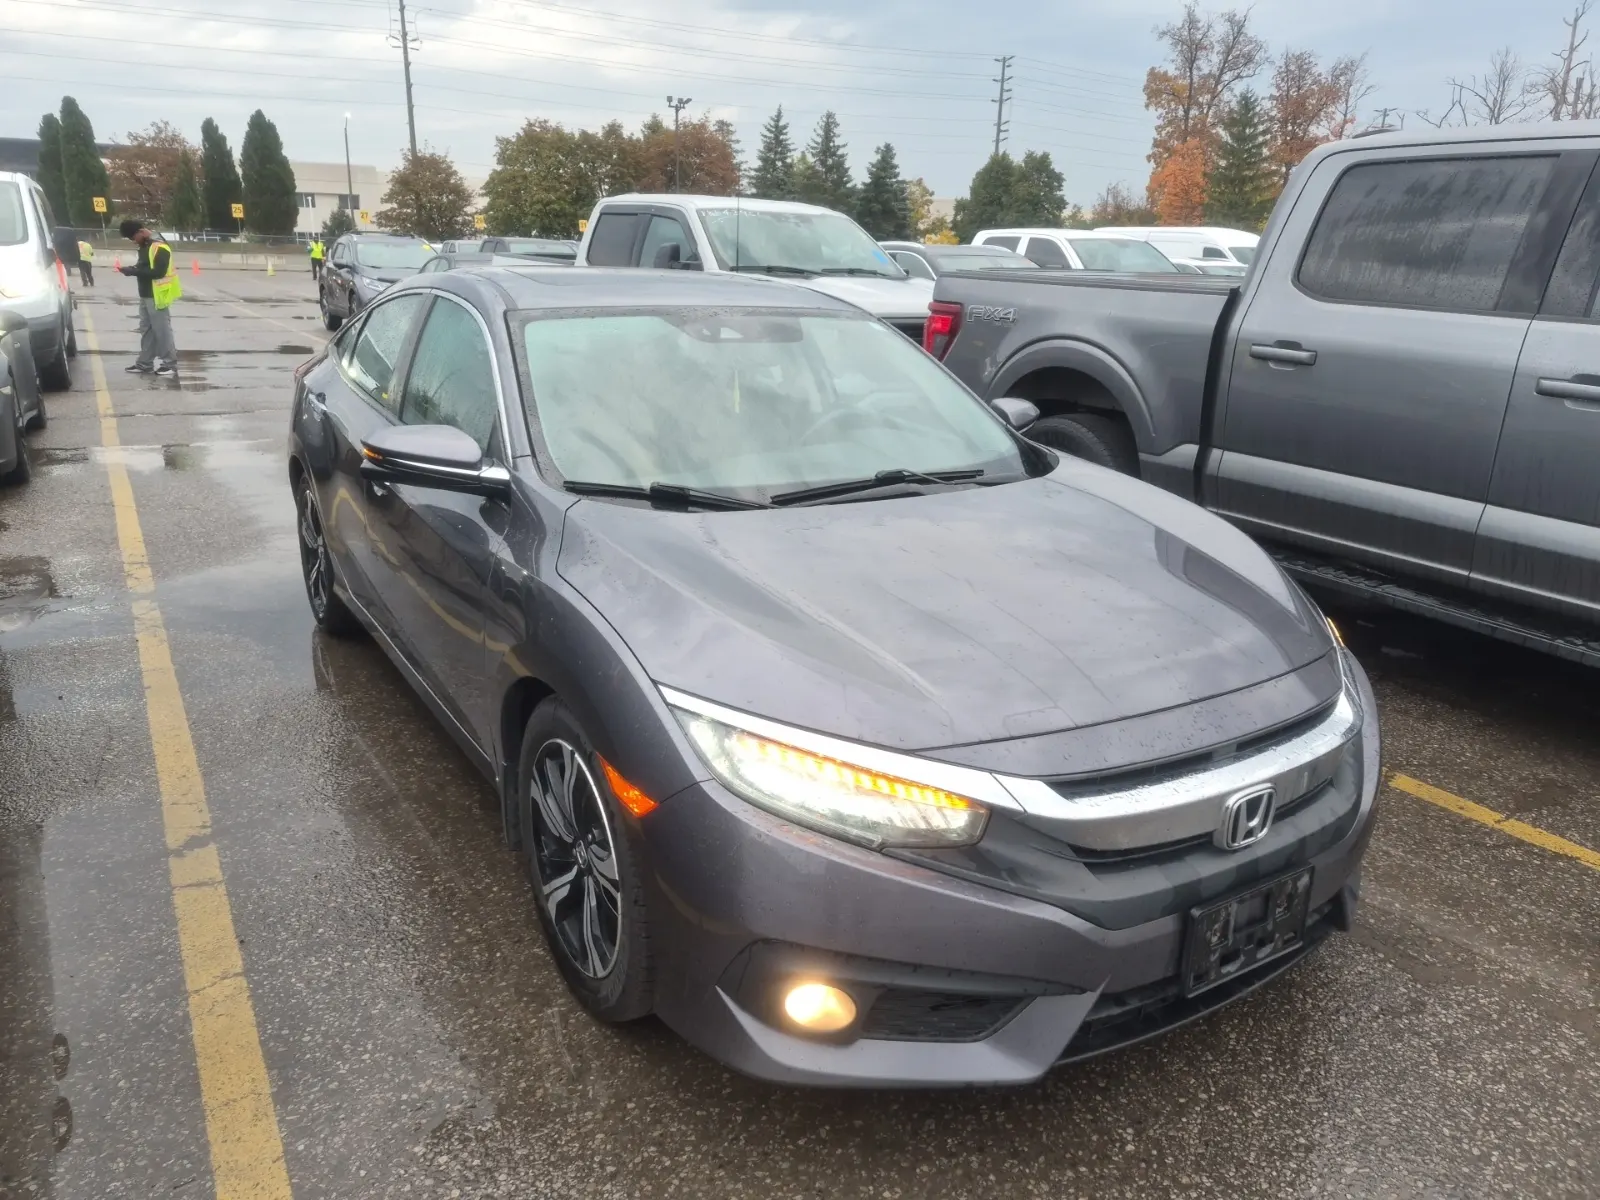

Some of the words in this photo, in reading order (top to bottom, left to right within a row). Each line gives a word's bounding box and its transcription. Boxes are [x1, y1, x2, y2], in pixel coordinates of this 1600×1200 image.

[94, 200, 105, 208] 23
[232, 206, 242, 214] 25
[967, 304, 1017, 321] FX4
